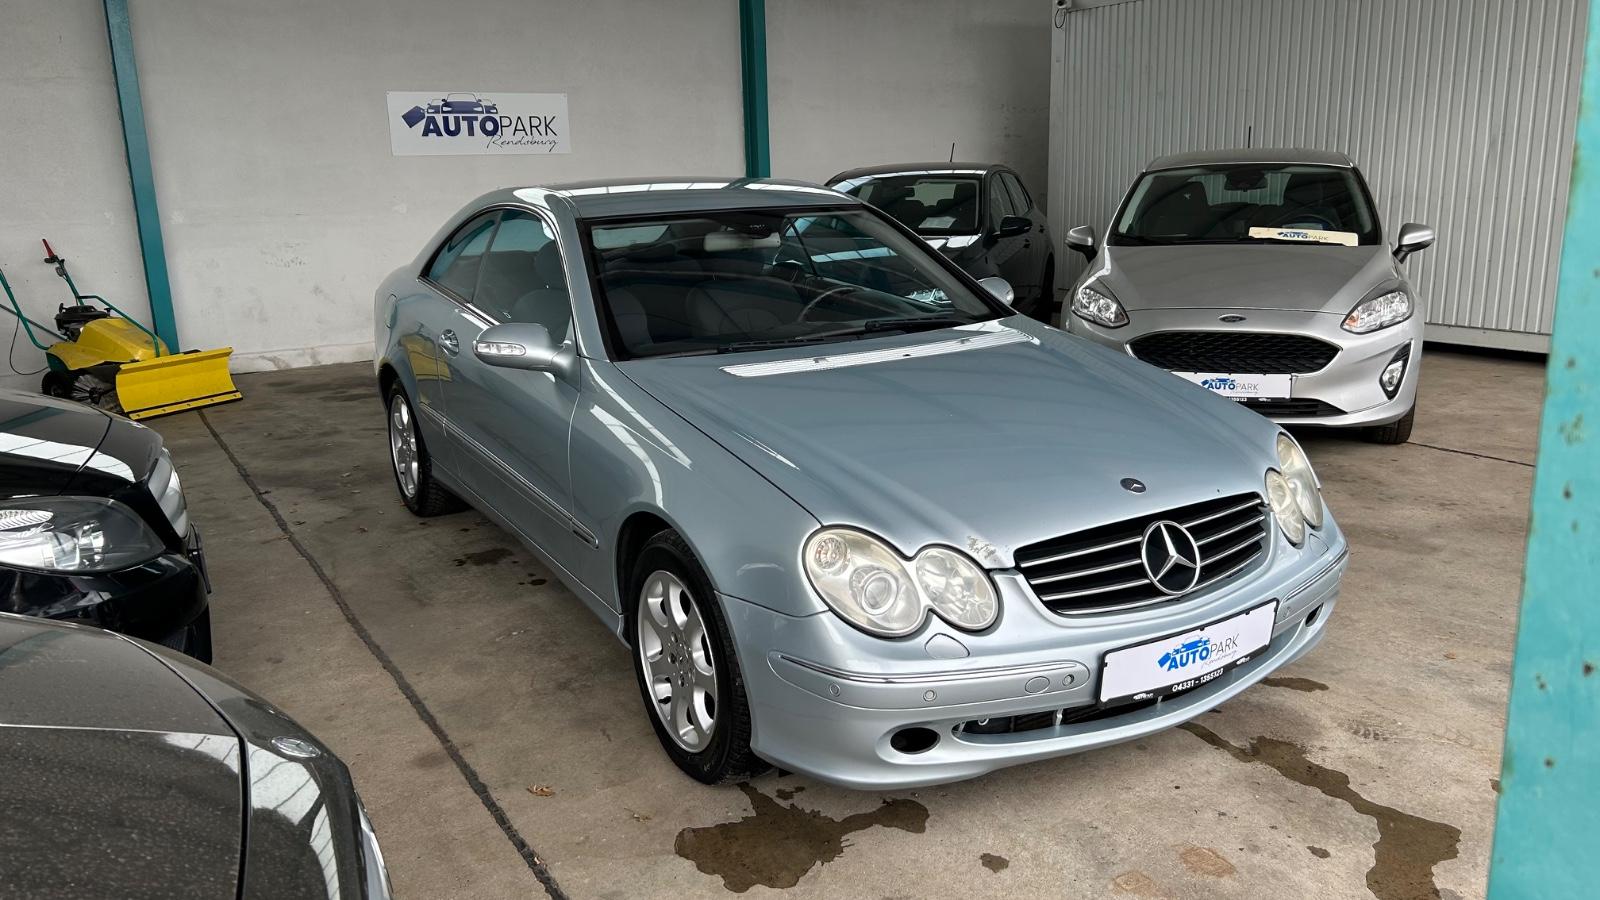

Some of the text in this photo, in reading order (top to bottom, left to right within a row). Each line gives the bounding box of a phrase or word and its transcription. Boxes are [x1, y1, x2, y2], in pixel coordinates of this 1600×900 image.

[421, 115, 558, 137] AUTOPARK
[486, 134, 558, 152] Rendsburg
[1167, 633, 1240, 672] AUTOPARK
[1172, 680, 1195, 692] 04331
